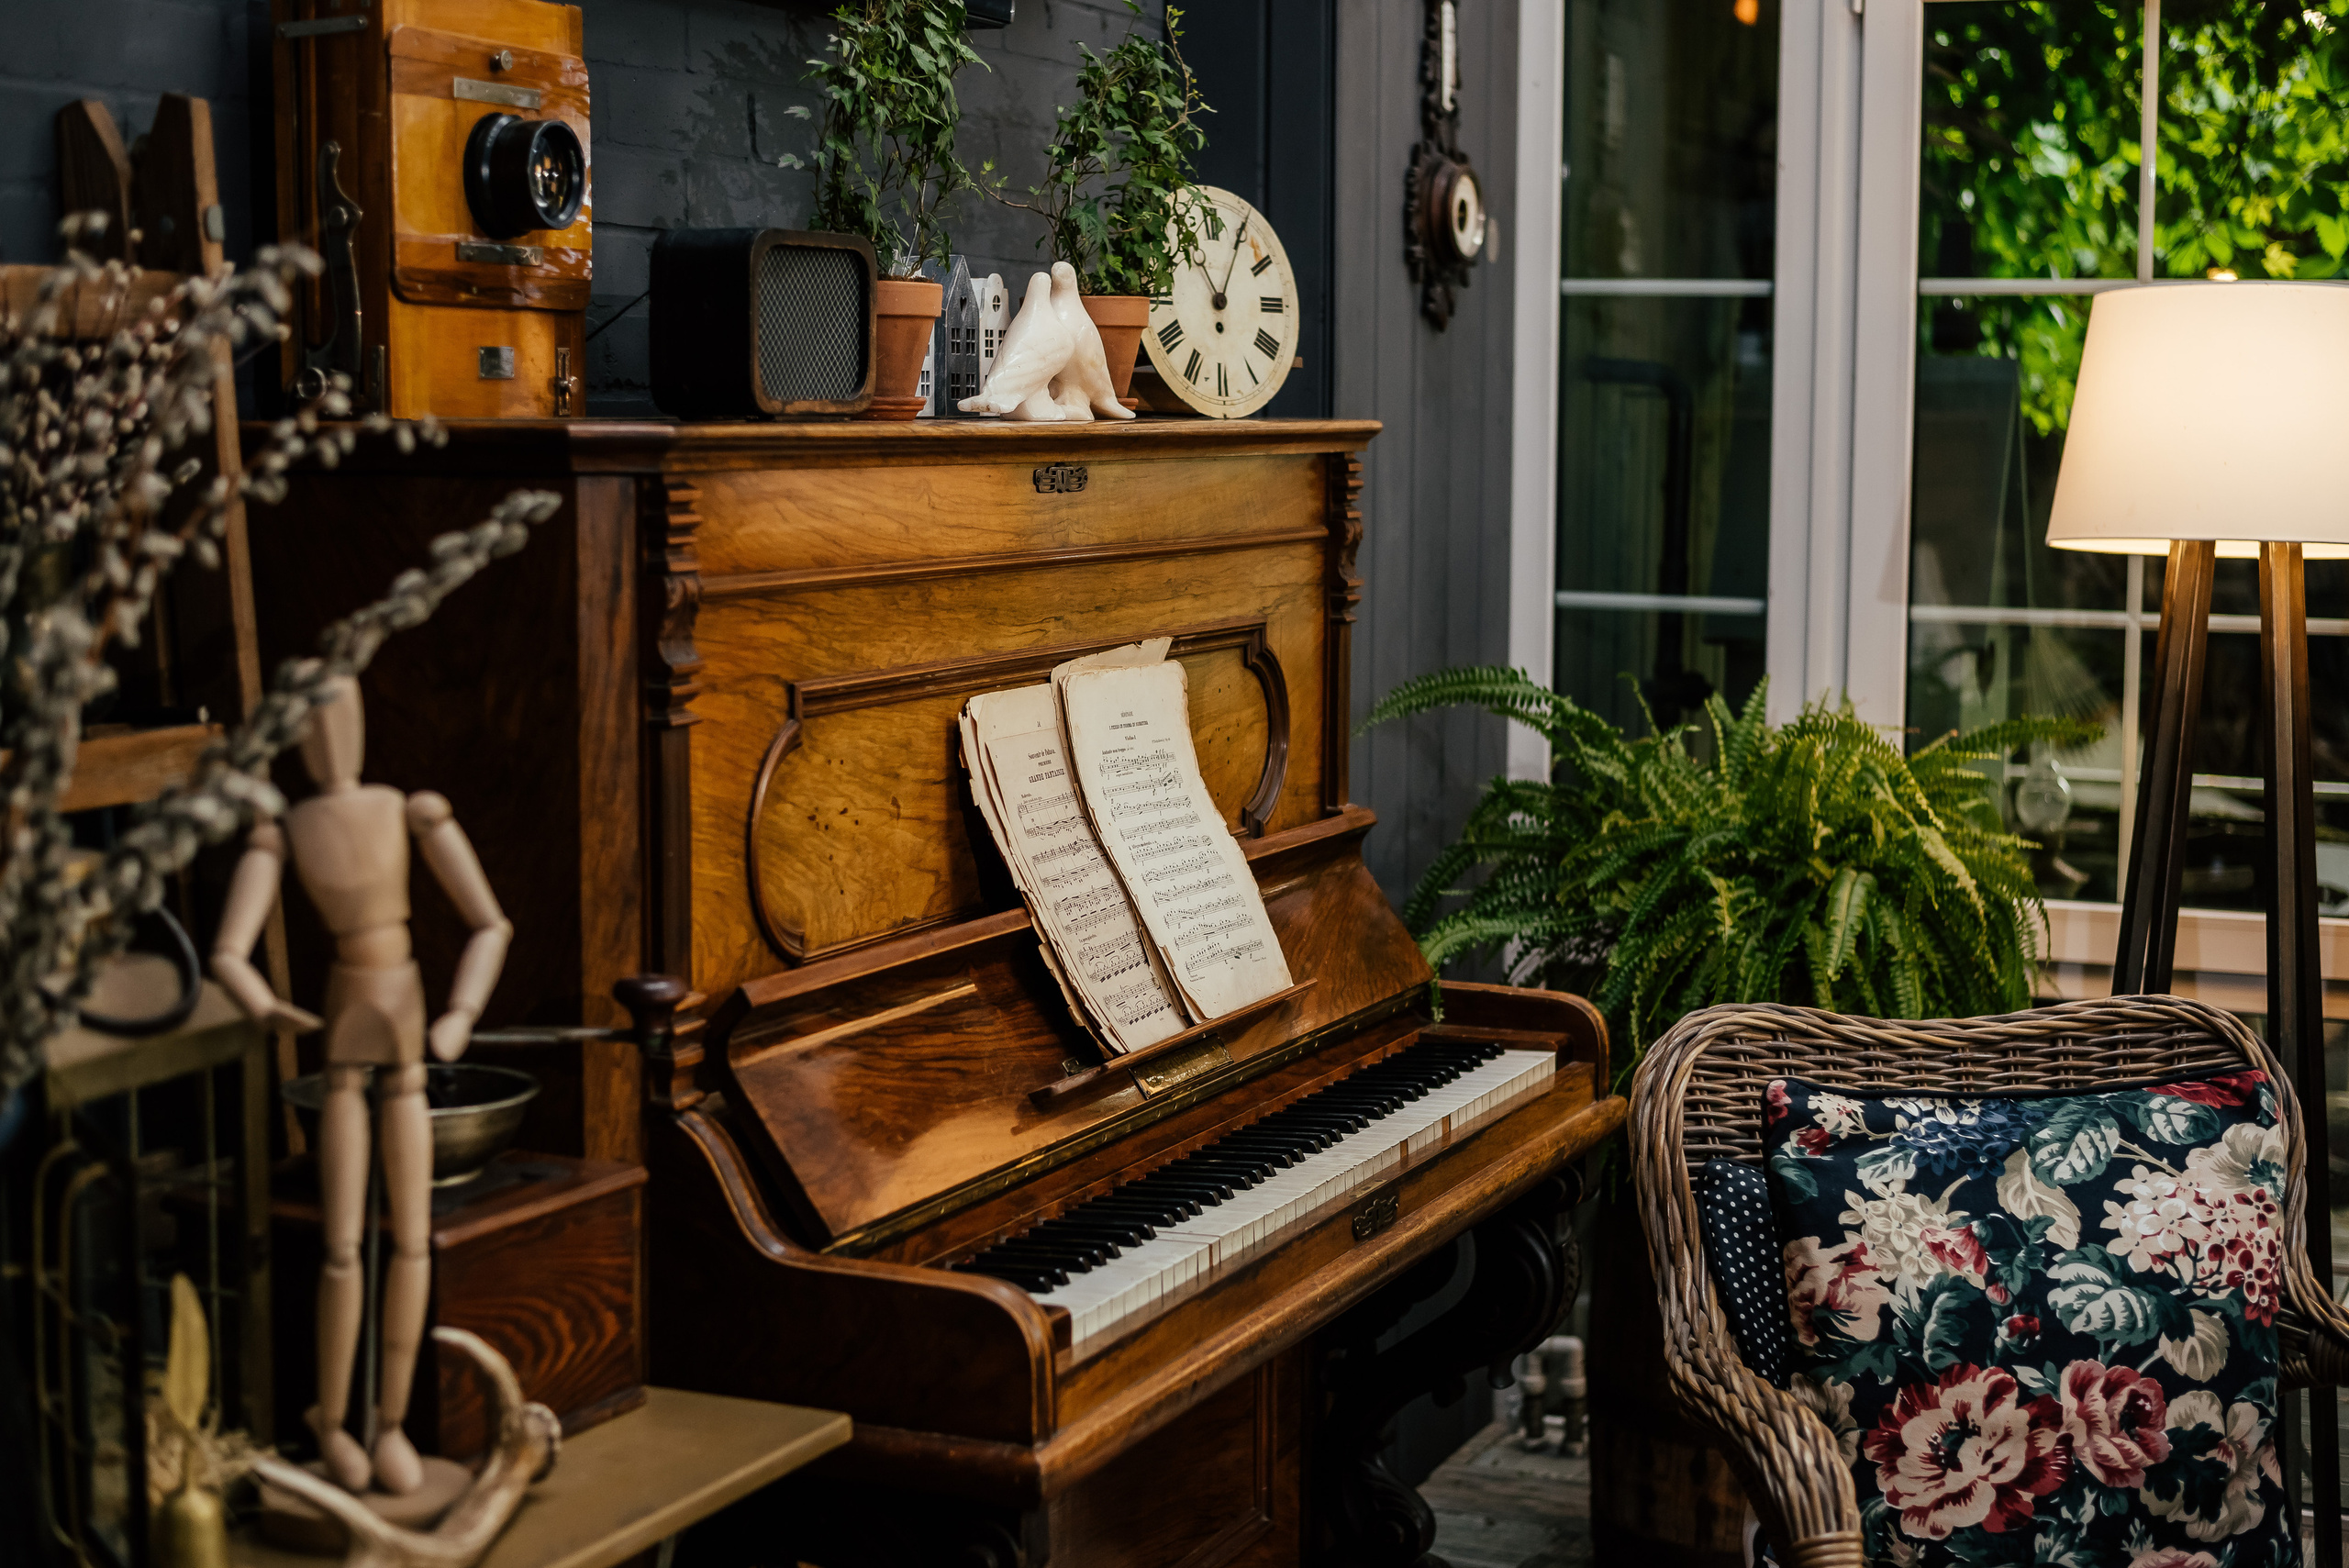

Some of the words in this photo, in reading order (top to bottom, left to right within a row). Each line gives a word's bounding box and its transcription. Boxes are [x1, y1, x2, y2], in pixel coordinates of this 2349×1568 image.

[1251, 254, 1273, 278] II
[1260, 296, 1283, 313] III
[1157, 318, 1186, 356] VIII
[1253, 327, 1280, 361] IIII
[1184, 348, 1204, 385] VII
[1217, 362, 1230, 396] VI
[1243, 355, 1259, 388] V
[1029, 773, 1044, 783] GRANDE
[1046, 768, 1064, 779] FANTAISIE
